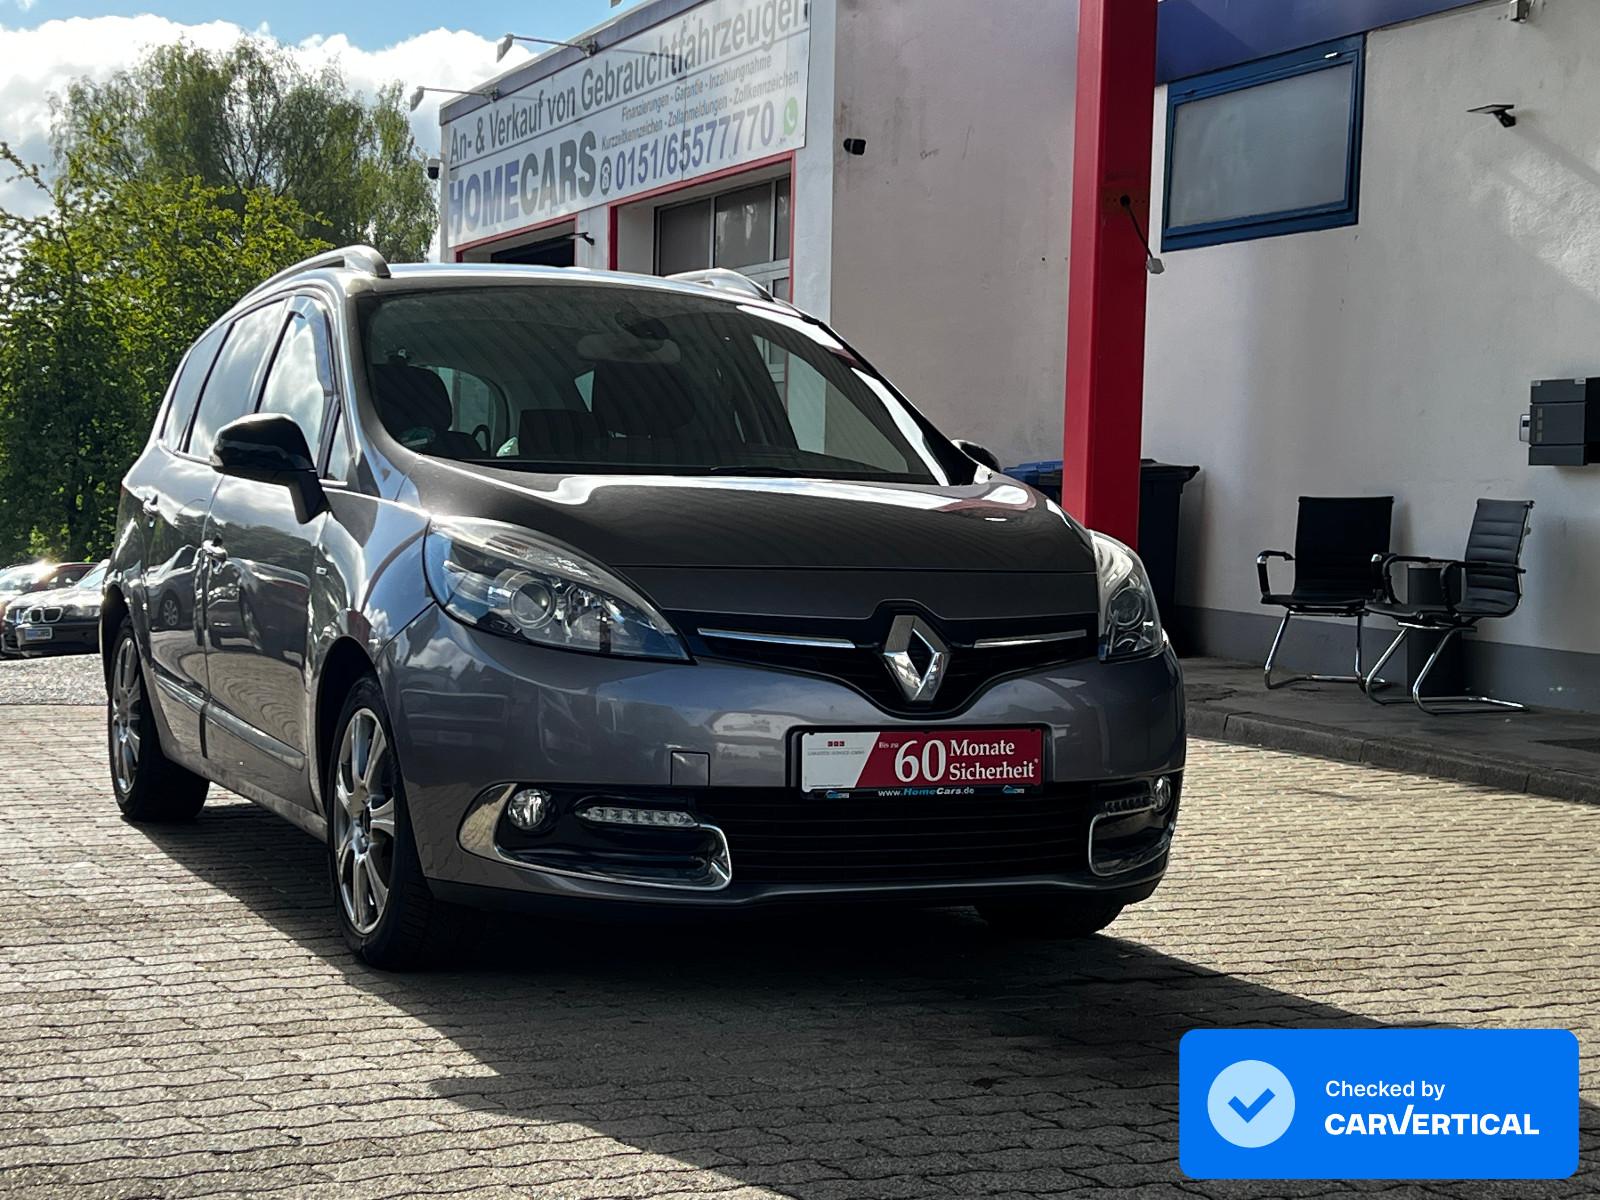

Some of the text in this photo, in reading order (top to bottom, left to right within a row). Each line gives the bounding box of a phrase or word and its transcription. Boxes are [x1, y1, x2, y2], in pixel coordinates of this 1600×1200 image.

[450, 0, 808, 164] An- & Verkauf von Gebrauchtfahrzeugen
[449, 130, 597, 235] HOMECARS
[616, 101, 775, 191] 0151/65577770
[878, 786, 975, 797] www.HomeCars.de
[894, 739, 947, 782] 60
[950, 739, 1015, 757] Monate
